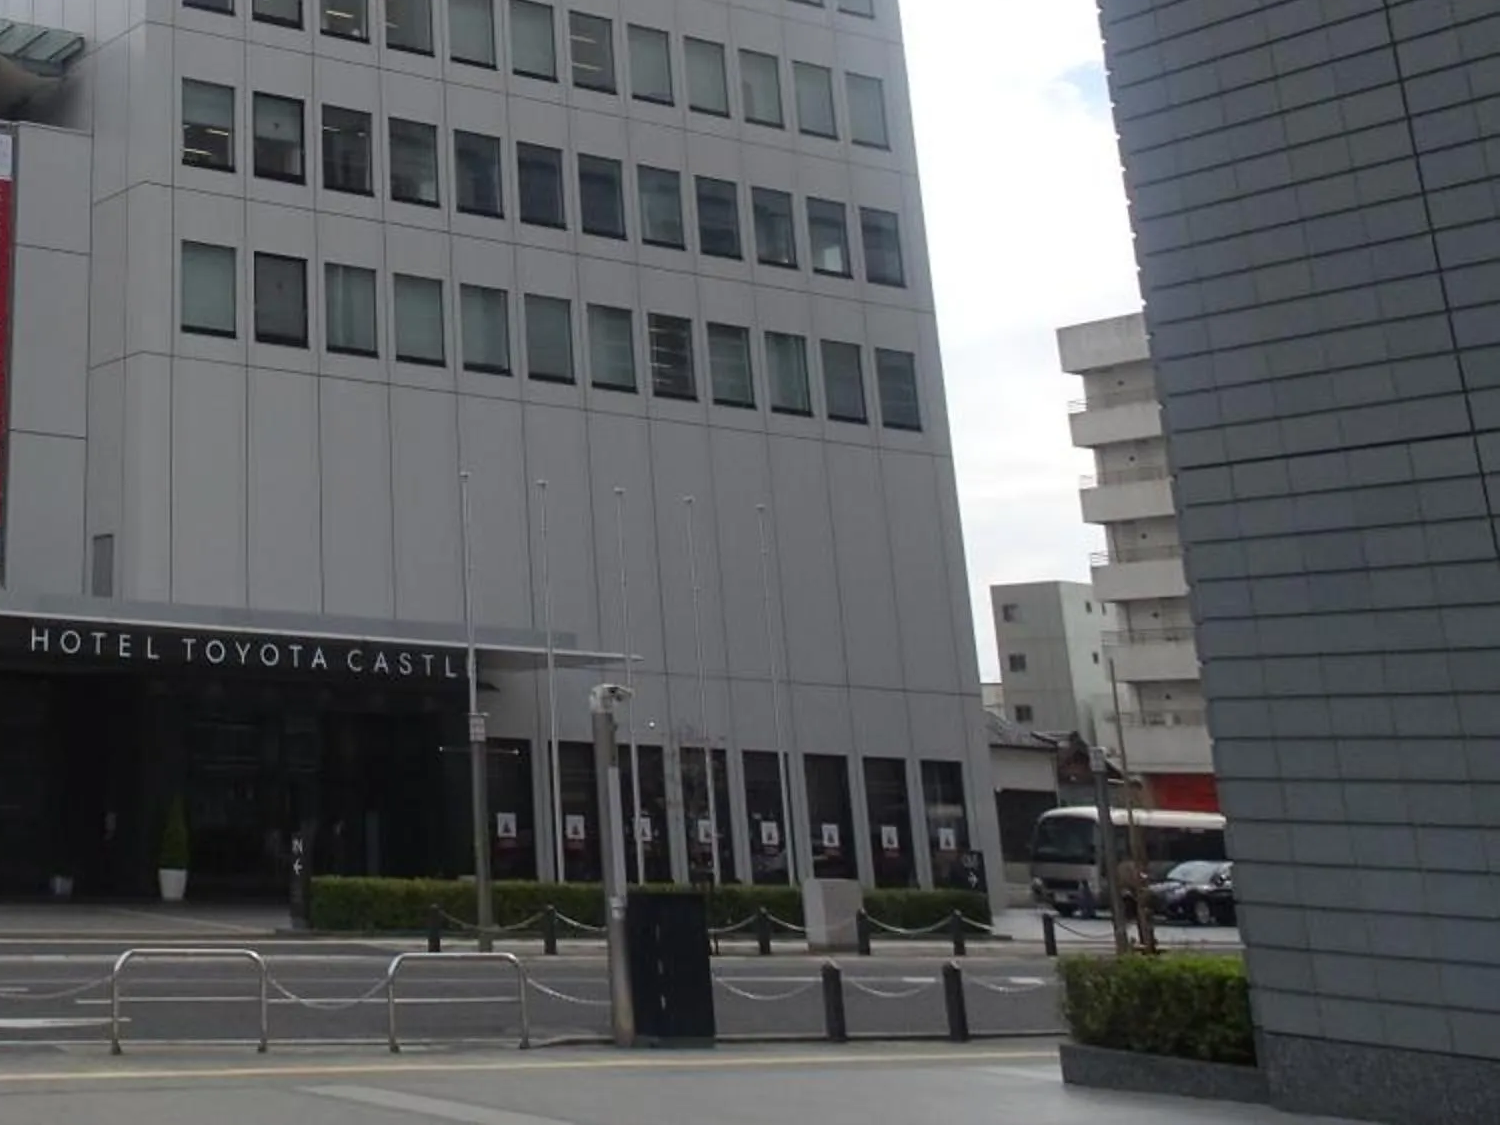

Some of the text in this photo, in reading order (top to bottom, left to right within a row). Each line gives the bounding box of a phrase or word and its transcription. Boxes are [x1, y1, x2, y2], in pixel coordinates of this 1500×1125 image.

[30, 627, 477, 679] HOTEL TOYOTA CASTL
